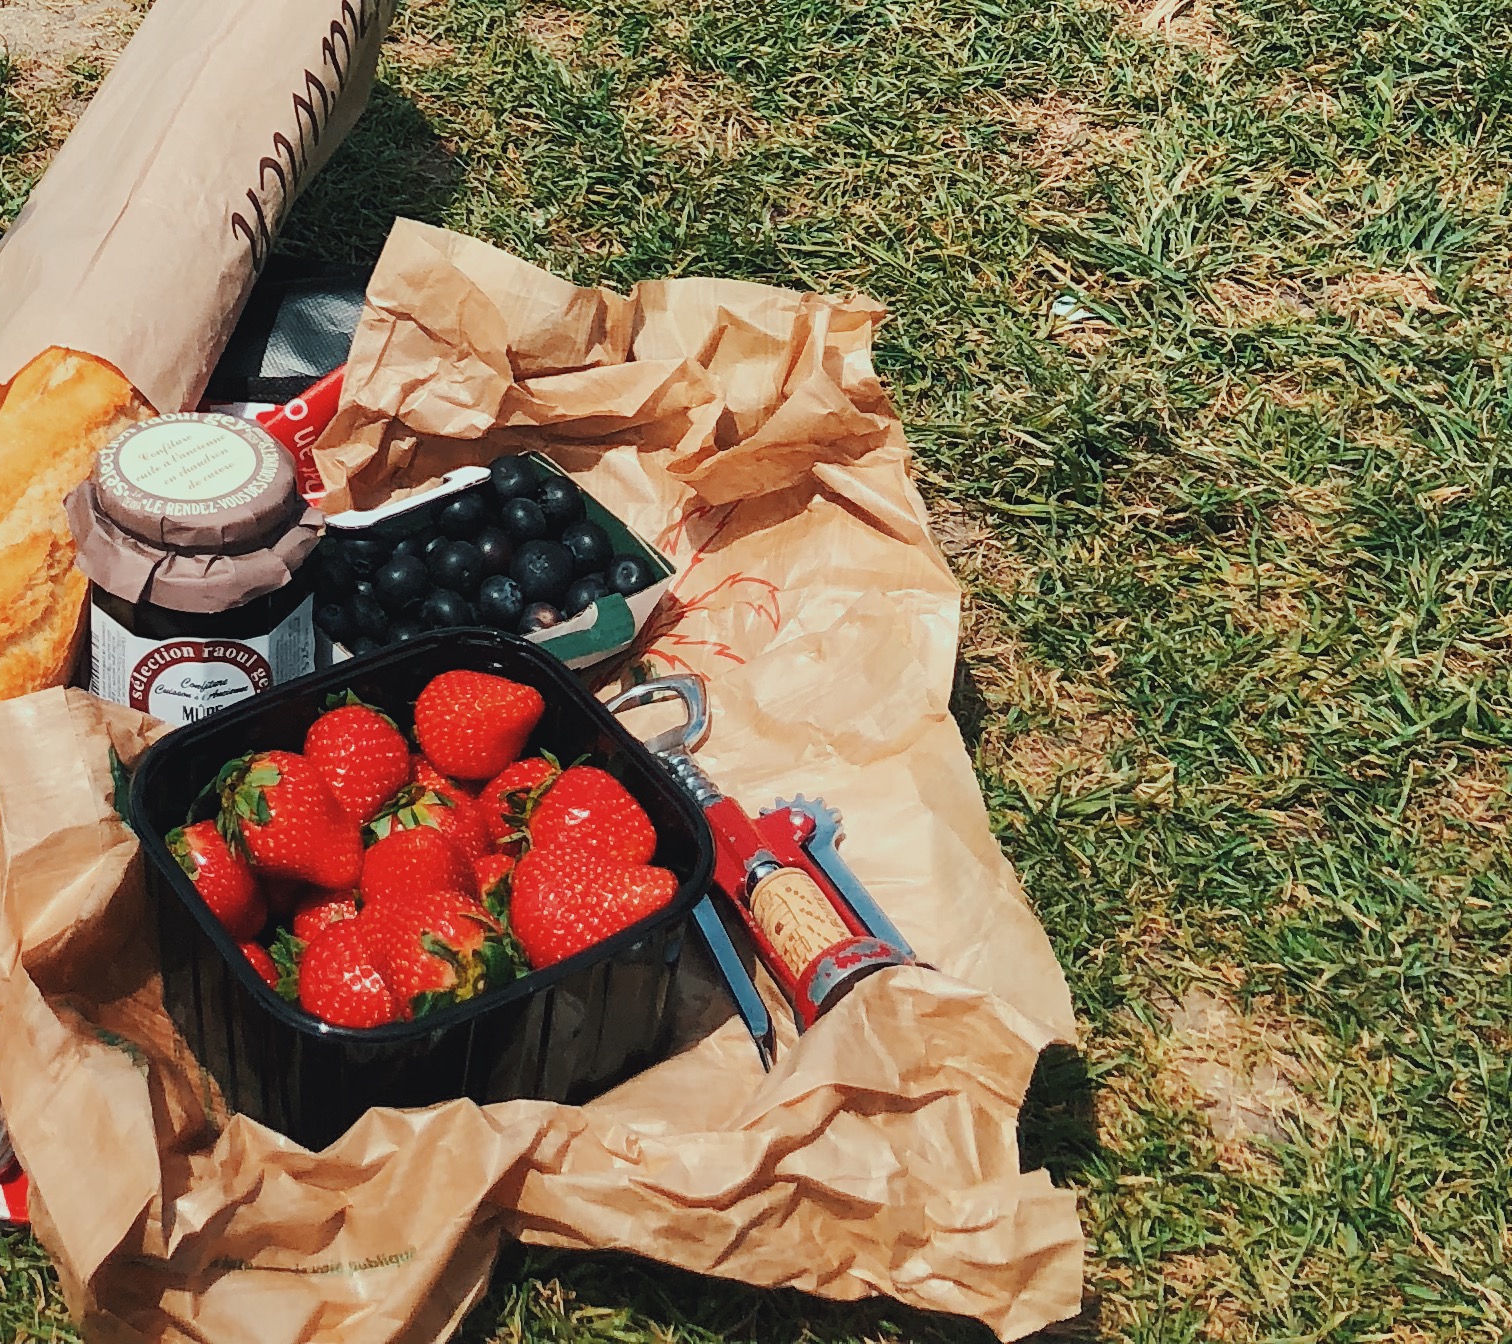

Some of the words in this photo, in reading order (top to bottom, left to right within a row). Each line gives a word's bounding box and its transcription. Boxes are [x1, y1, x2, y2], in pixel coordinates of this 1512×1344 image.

[138, 434, 193, 462] Confiture
[145, 498, 161, 513] LE
[165, 492, 250, 517] RENDEZ-VOUS
[246, 478, 269, 498] DES
[131, 645, 196, 700] sélection
[202, 643, 257, 667] raoul
[250, 667, 270, 693] ge
[180, 677, 229, 692] Confiture
